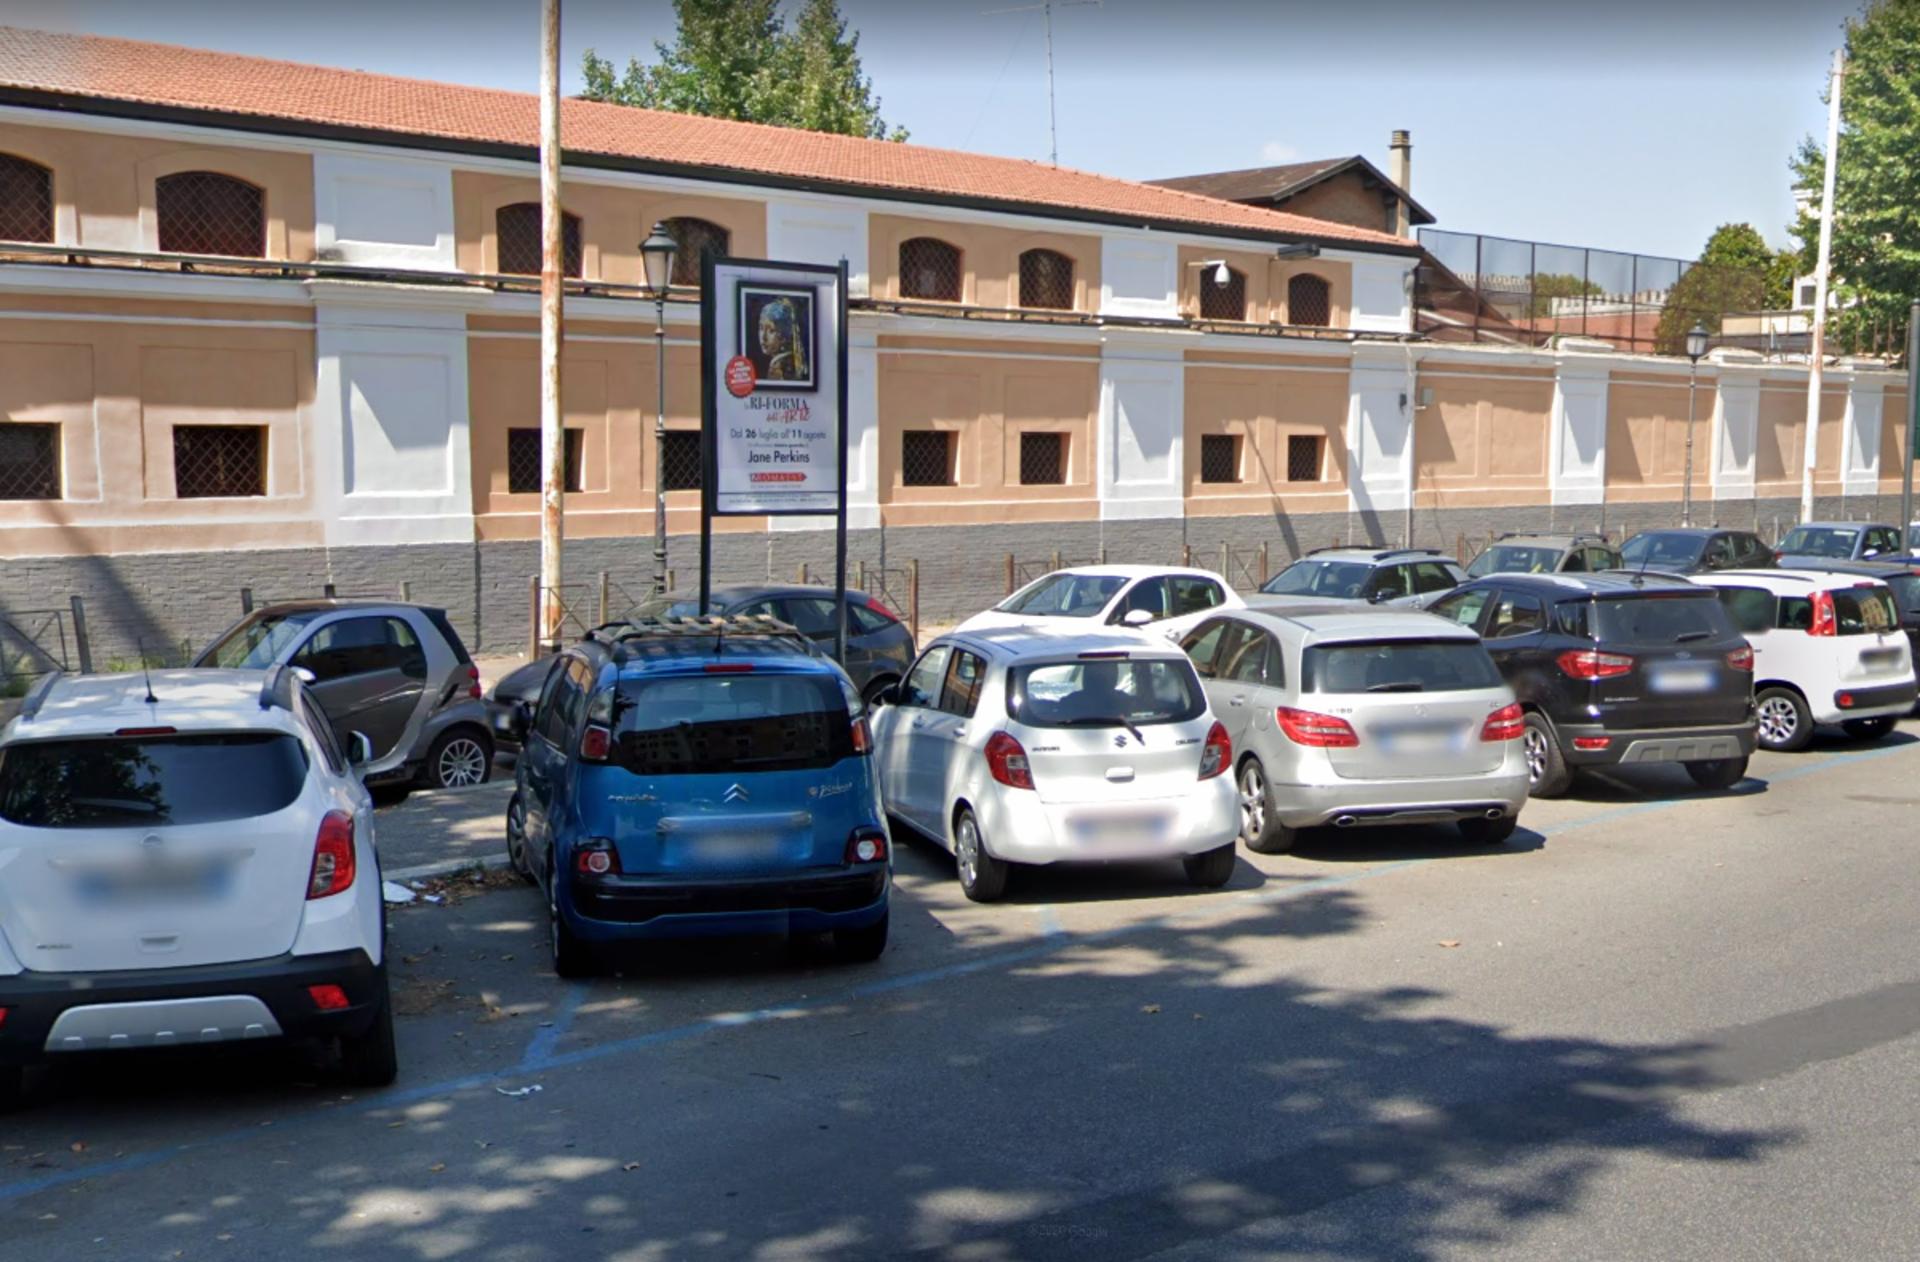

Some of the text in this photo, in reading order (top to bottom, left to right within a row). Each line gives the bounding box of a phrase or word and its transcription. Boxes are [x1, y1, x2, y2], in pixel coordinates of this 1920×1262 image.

[750, 396, 808, 411] RI-FORMA
[730, 428, 742, 439] Dal
[745, 428, 757, 439] 26
[748, 450, 810, 463] Jane Perkins
